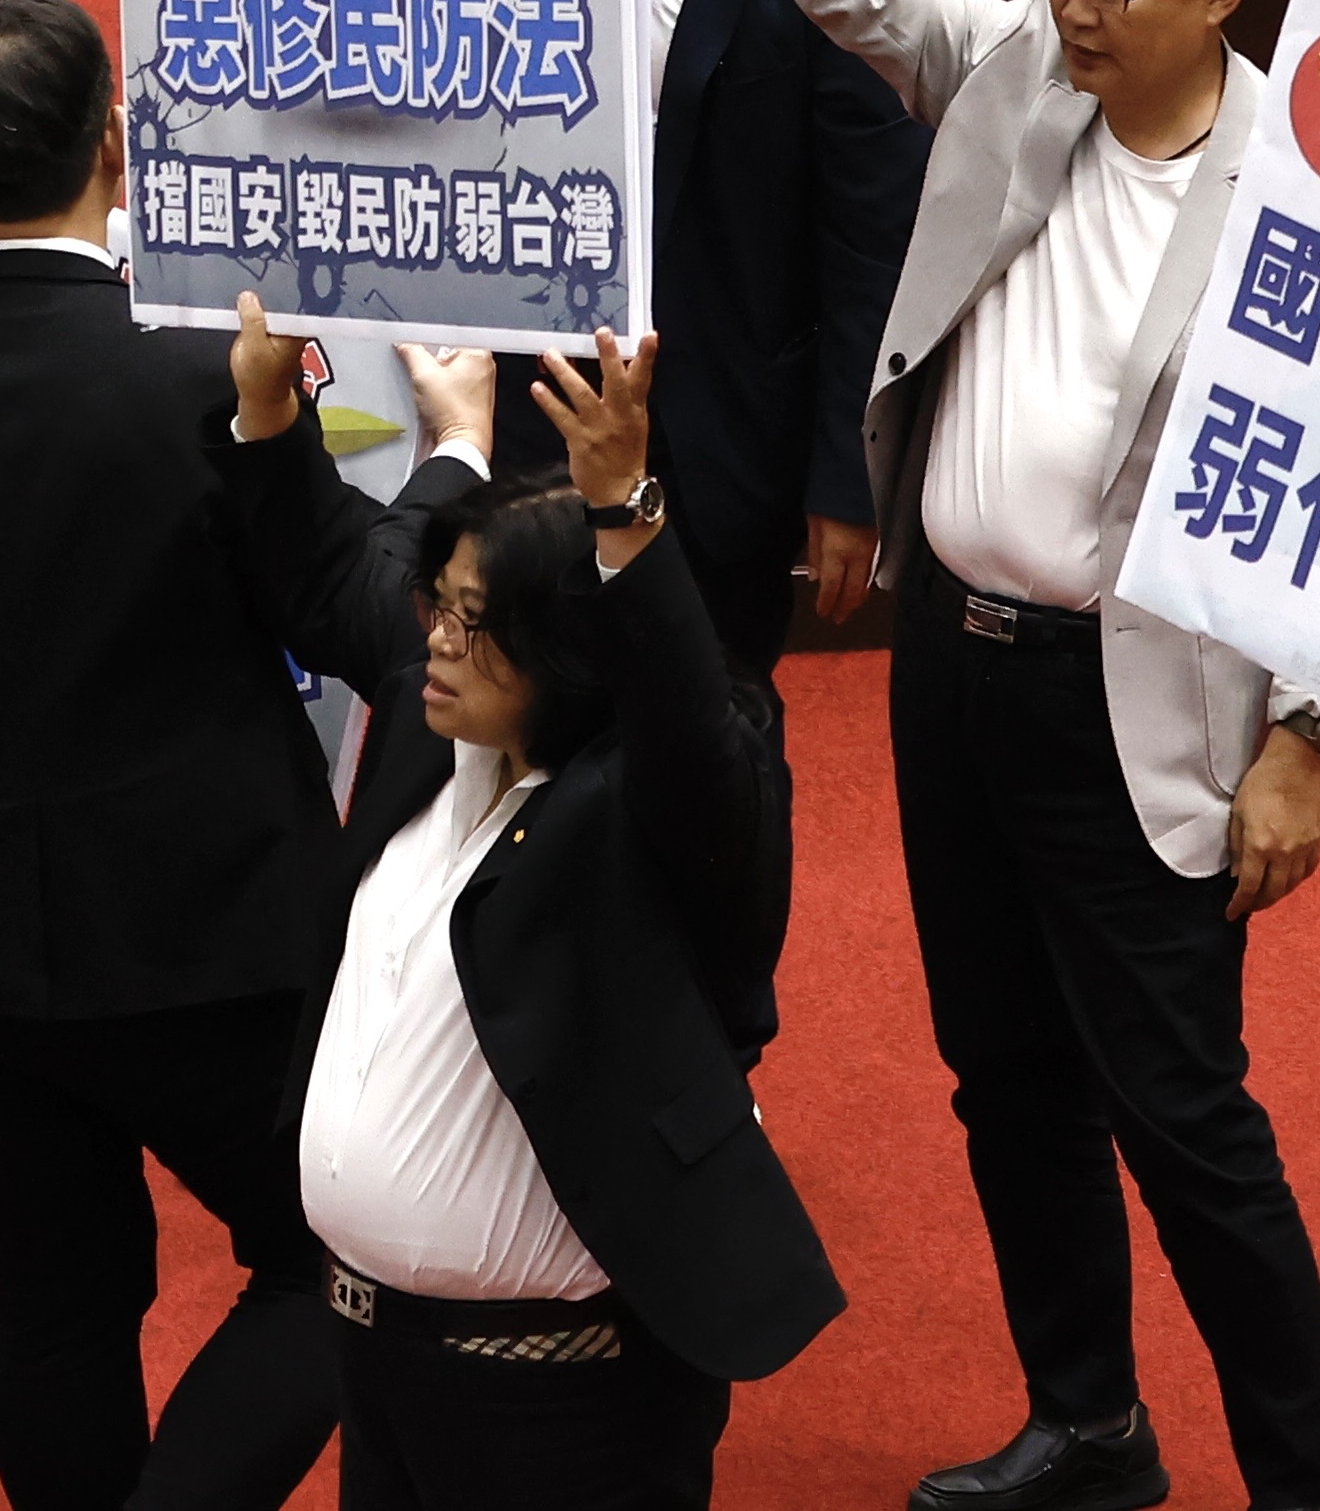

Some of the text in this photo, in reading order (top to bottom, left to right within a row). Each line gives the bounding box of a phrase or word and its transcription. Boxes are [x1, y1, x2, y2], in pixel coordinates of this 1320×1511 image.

[143, 163, 616, 268] 擋國安 毀民防 弱台灣
